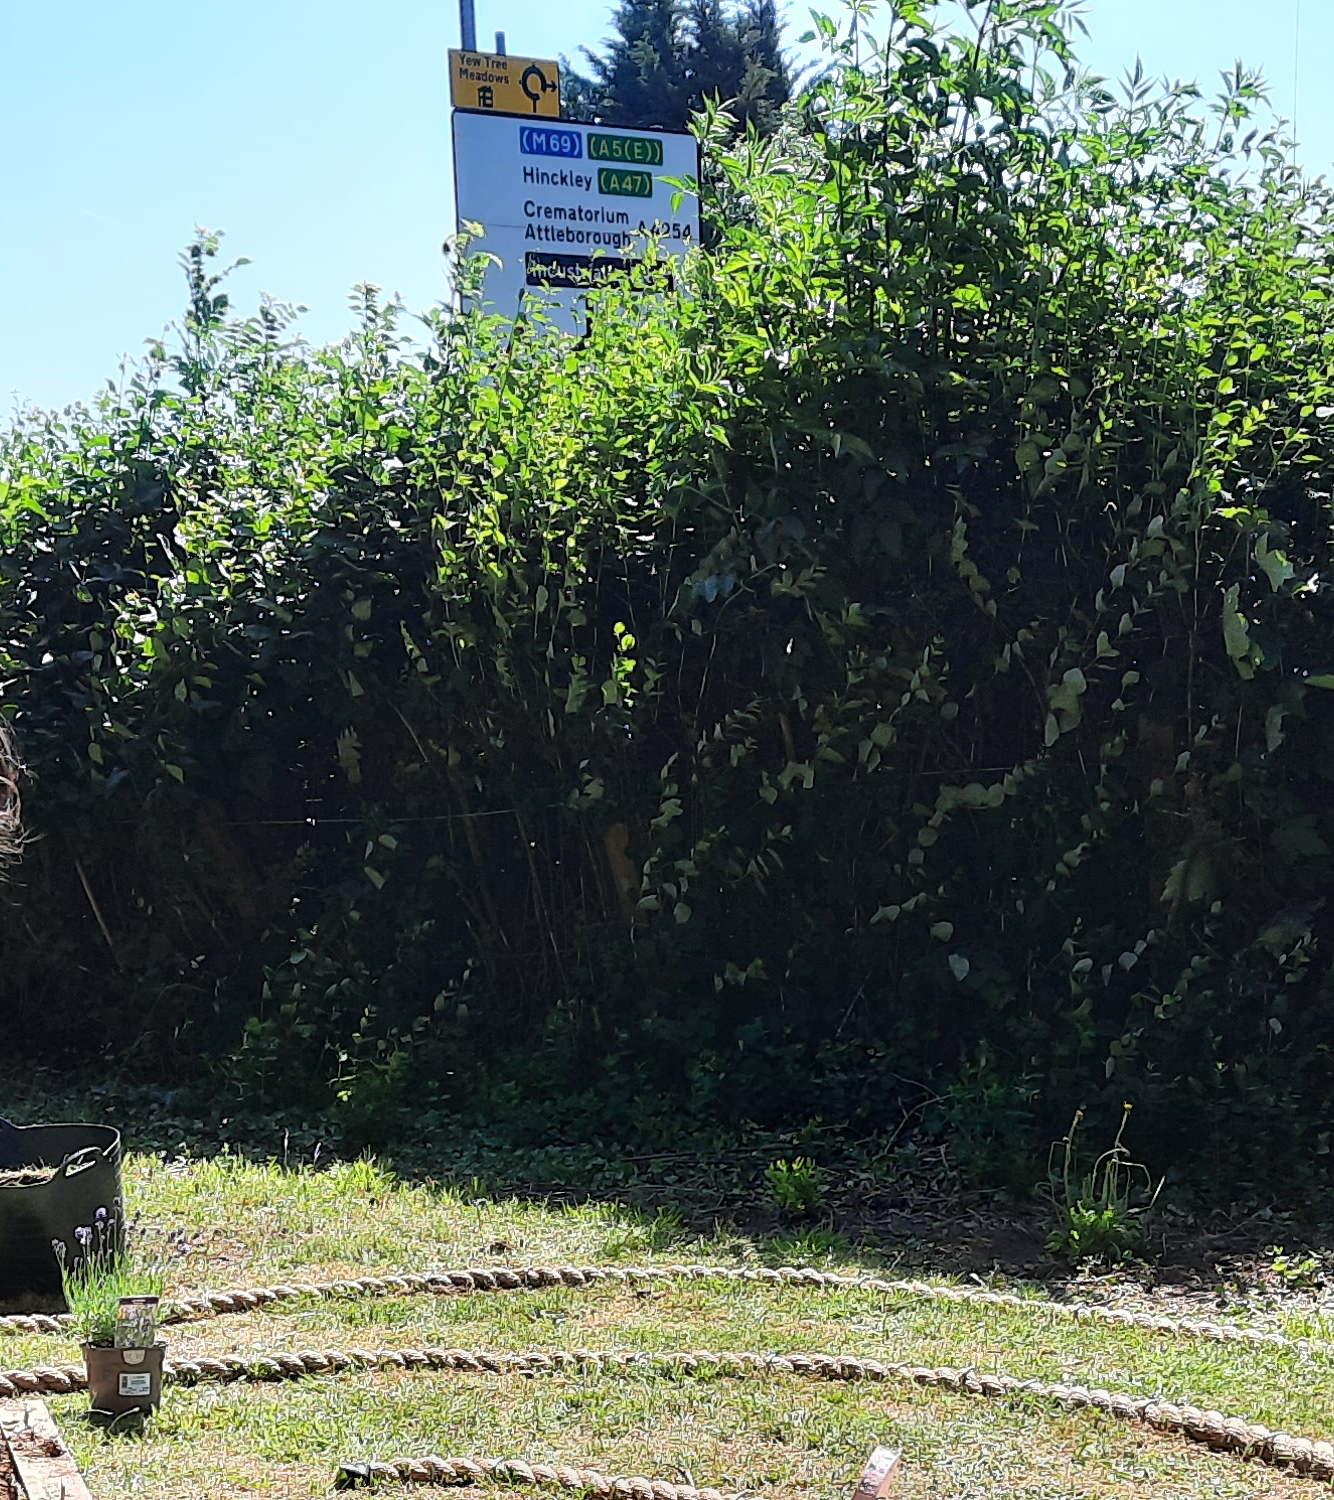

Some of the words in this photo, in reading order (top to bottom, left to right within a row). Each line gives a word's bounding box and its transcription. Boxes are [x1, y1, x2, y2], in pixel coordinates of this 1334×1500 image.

[459, 54, 481, 66] Yew
[484, 56, 508, 70] Tree
[459, 67, 509, 84] Meadows
[523, 166, 592, 191] Hinckley
[600, 172, 651, 194] (A47)
[523, 200, 629, 225] Crematorium
[524, 223, 631, 249] Attleborough
